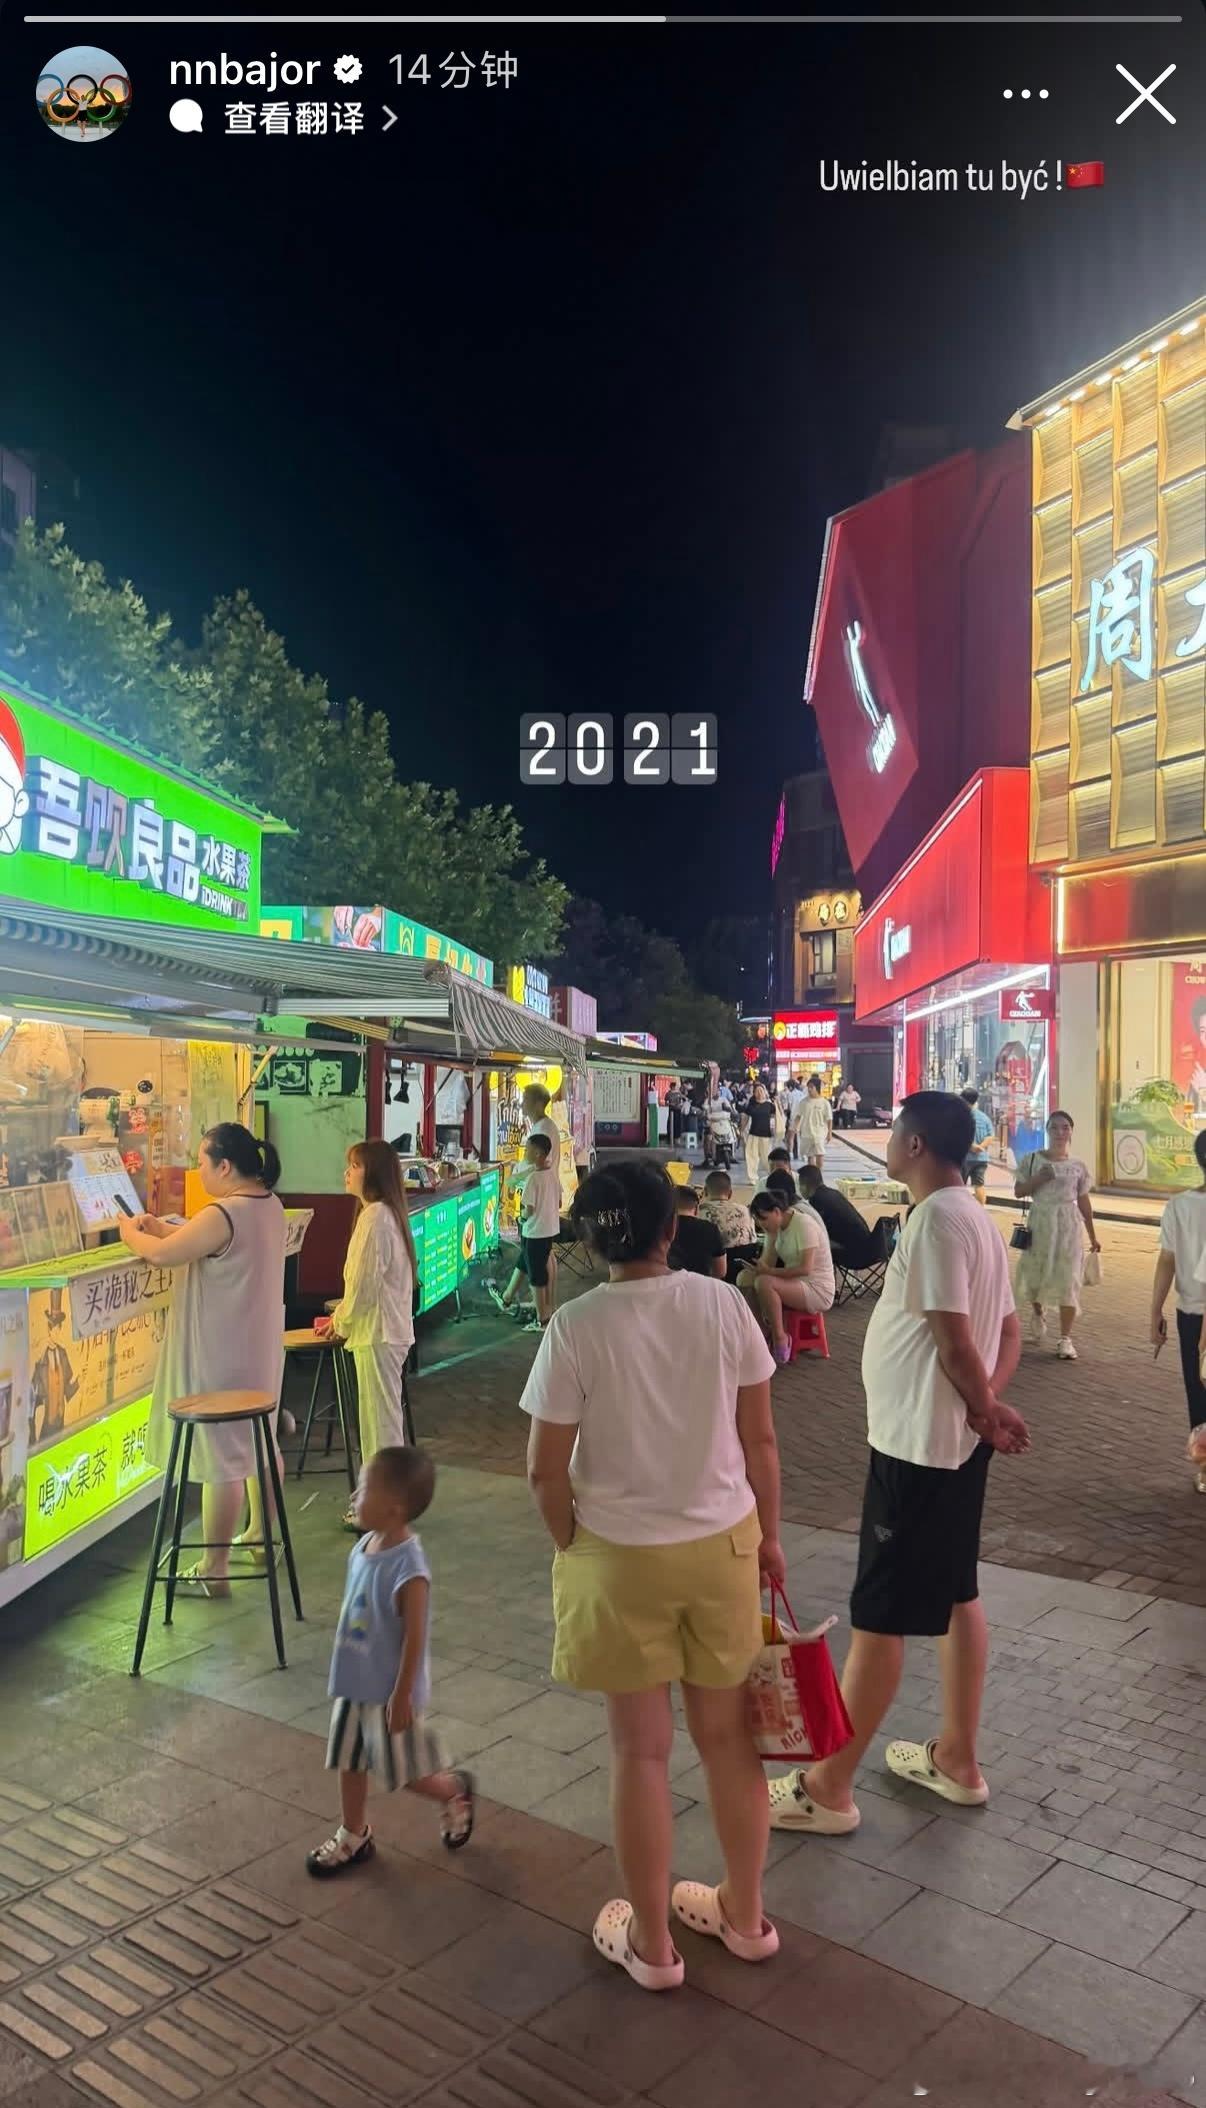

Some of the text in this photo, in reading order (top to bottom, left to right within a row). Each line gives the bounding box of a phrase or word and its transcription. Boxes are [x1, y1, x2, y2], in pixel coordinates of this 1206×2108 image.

[202, 836, 251, 890] 水果茶
[83, 1266, 173, 1325] 买诡秘之主
